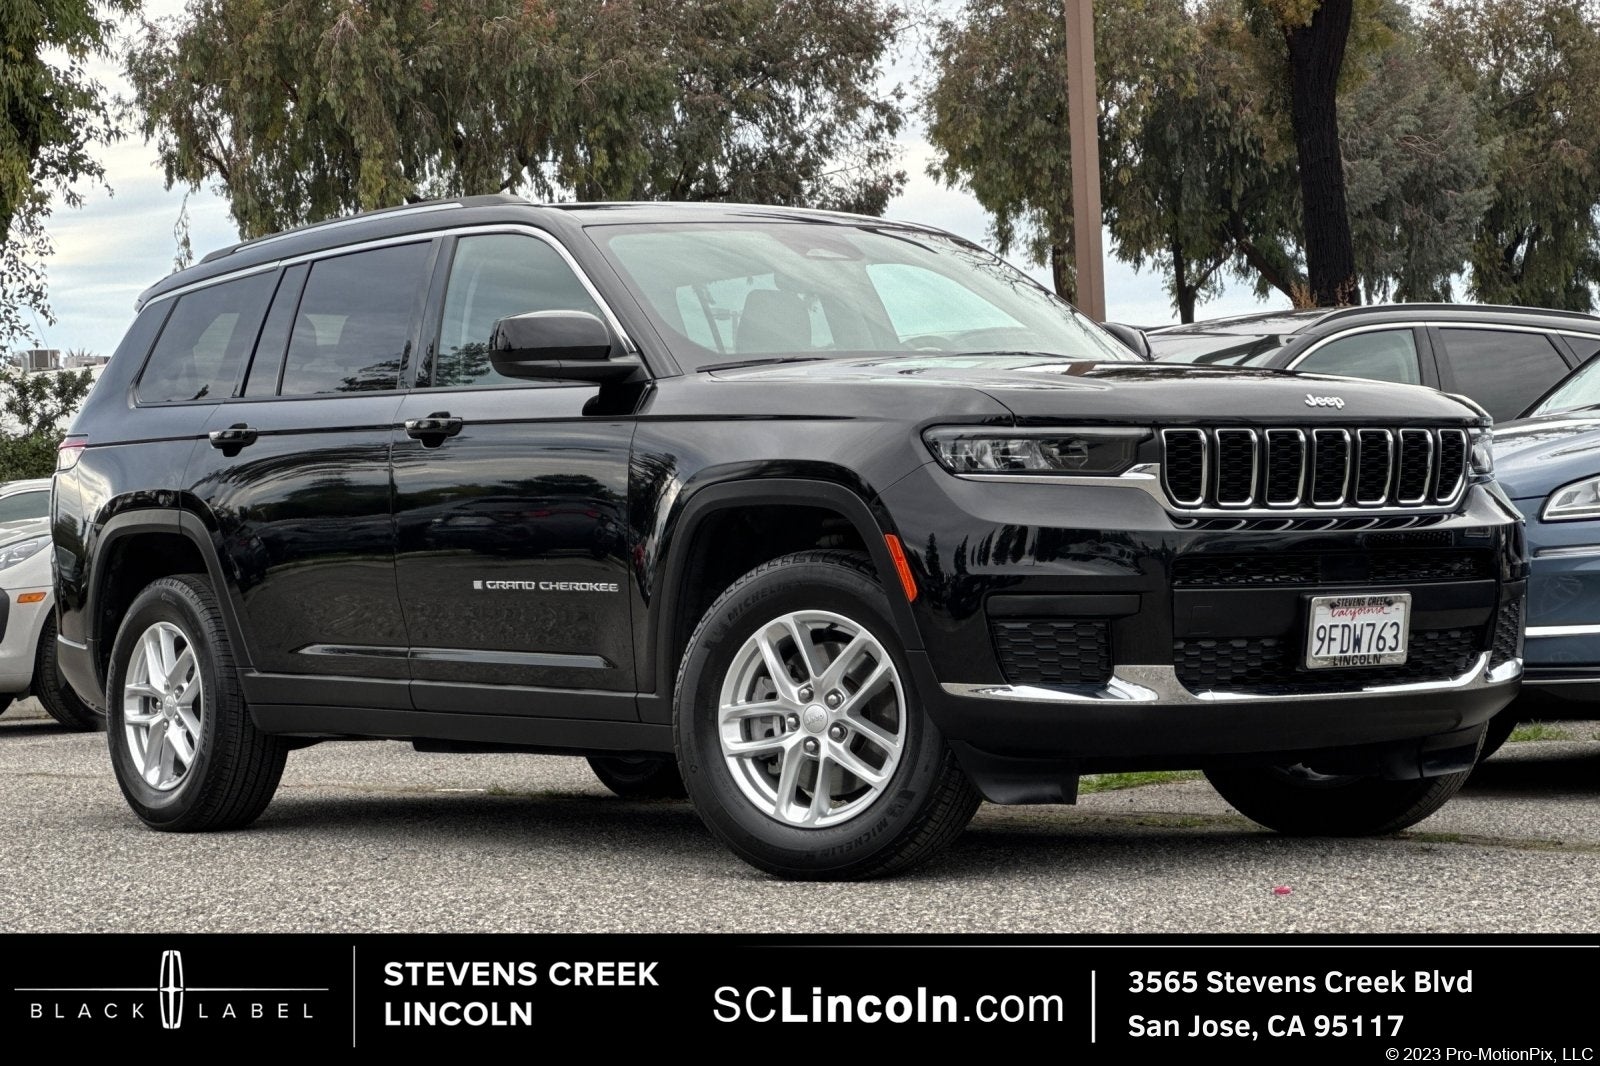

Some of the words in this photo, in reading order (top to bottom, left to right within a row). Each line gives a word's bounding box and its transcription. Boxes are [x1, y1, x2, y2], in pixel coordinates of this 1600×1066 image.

[1304, 393, 1345, 409] Jeep
[486, 580, 535, 590] GRAND
[539, 582, 619, 592] CHEROKEE
[1336, 597, 1366, 607] STEVENS
[1331, 607, 1391, 621] California
[1314, 621, 1400, 655] 9FDW763
[1332, 654, 1382, 667] LINCOLN
